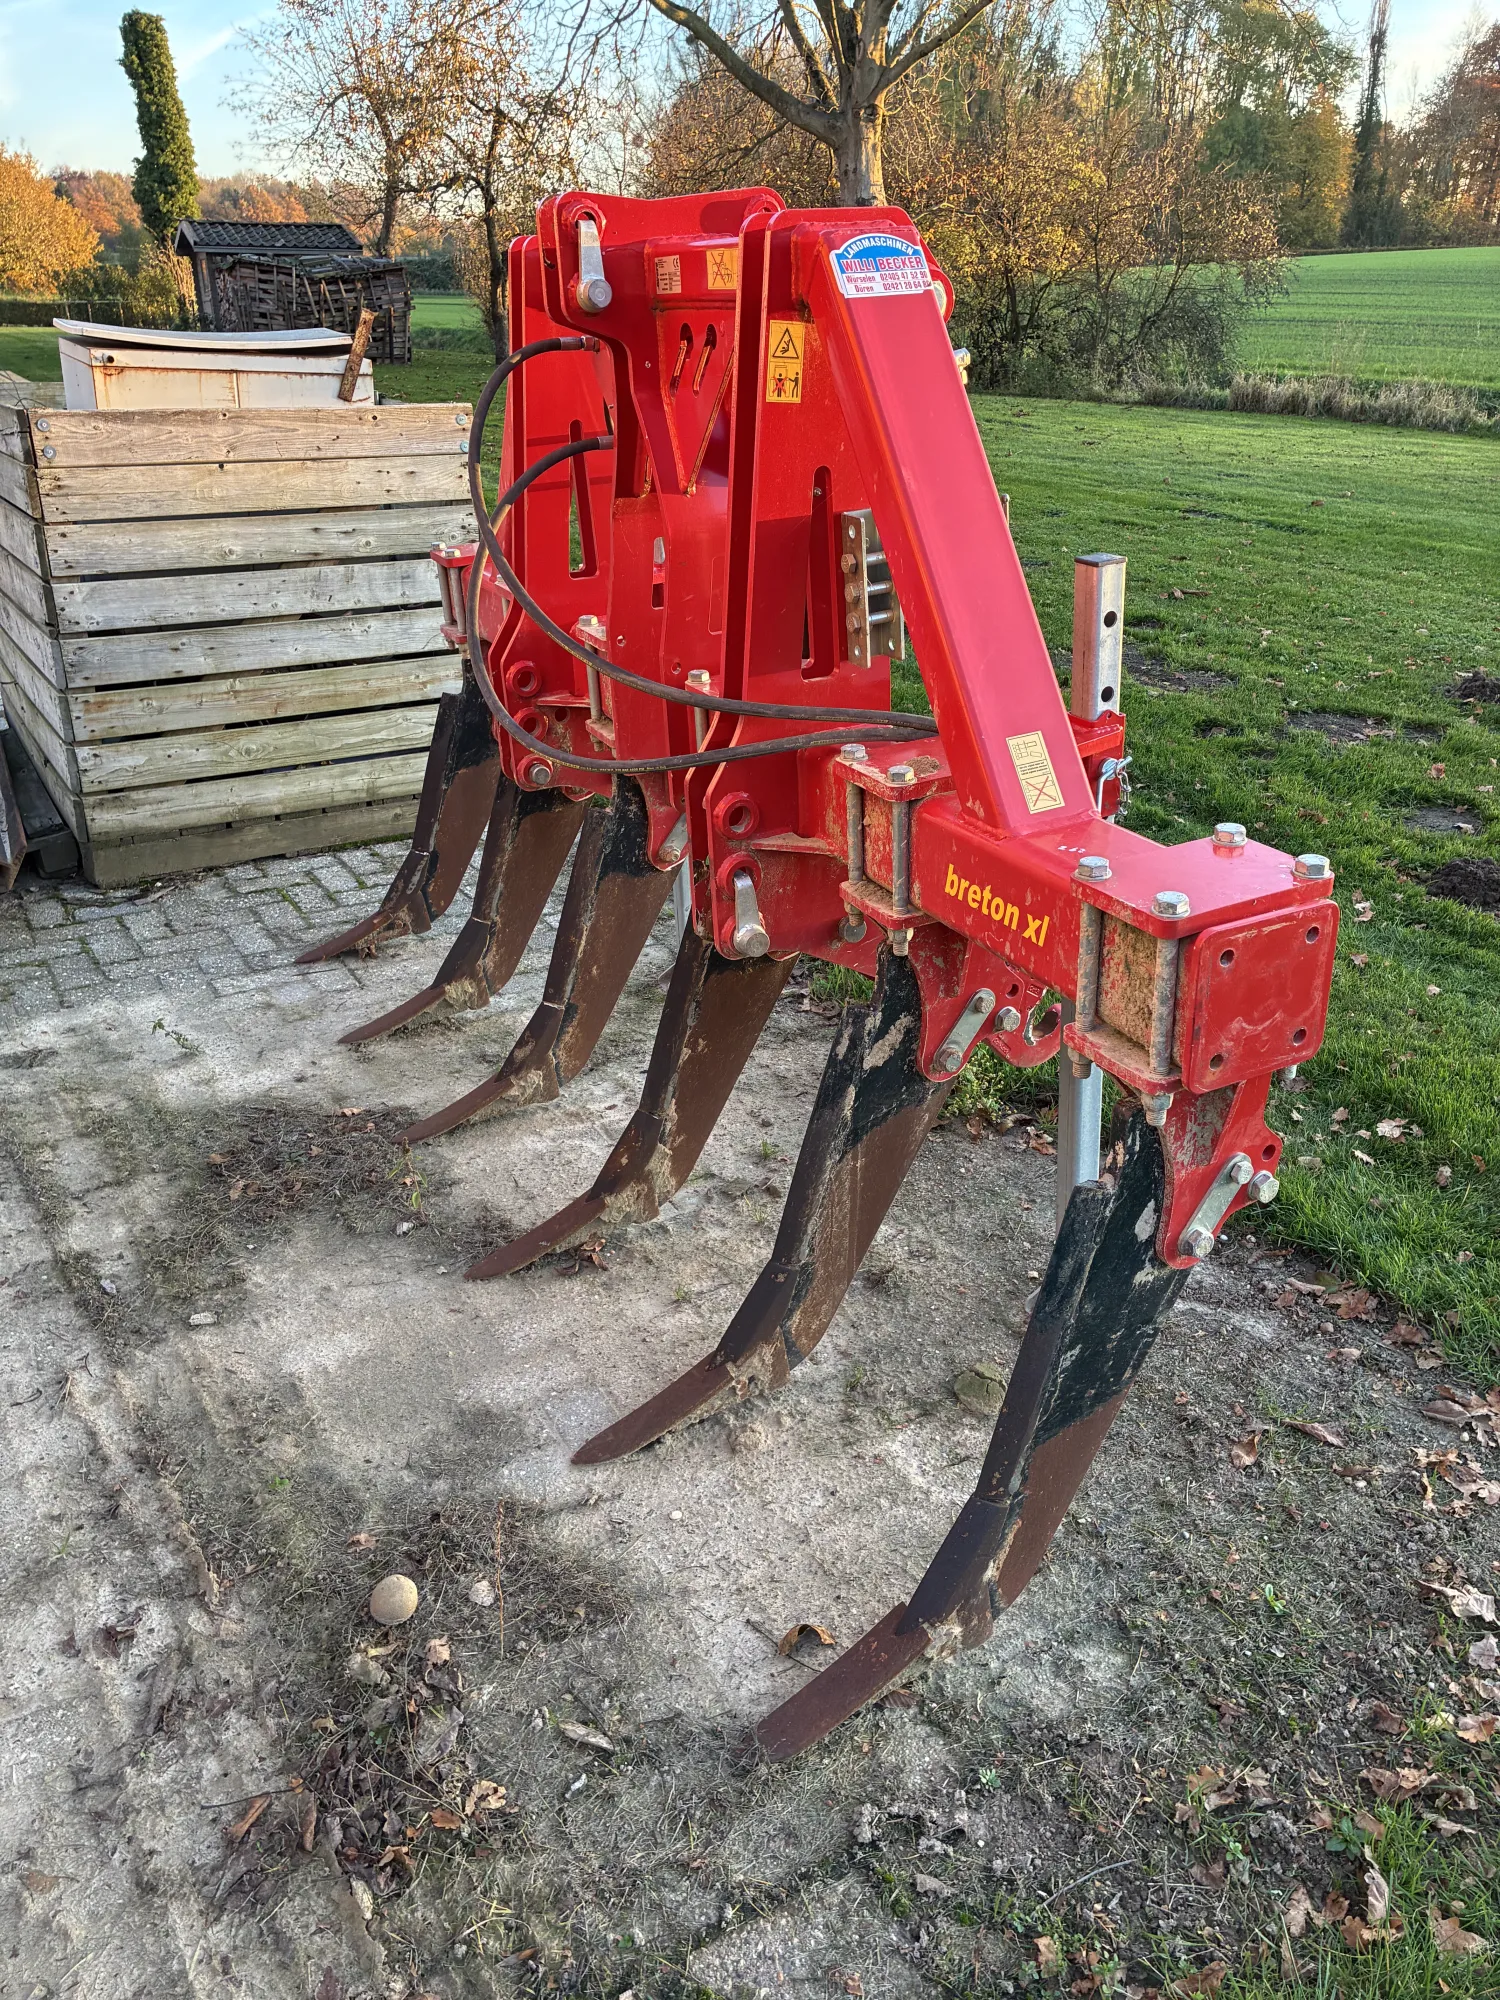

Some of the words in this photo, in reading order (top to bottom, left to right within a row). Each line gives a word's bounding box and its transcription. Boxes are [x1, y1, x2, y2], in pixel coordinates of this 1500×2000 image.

[843, 237, 914, 259] LANDMASCHINEN
[842, 259, 875, 272] WILLI
[877, 256, 924, 271] BECKER
[945, 863, 1020, 931] breton
[1022, 913, 1050, 947] xl
